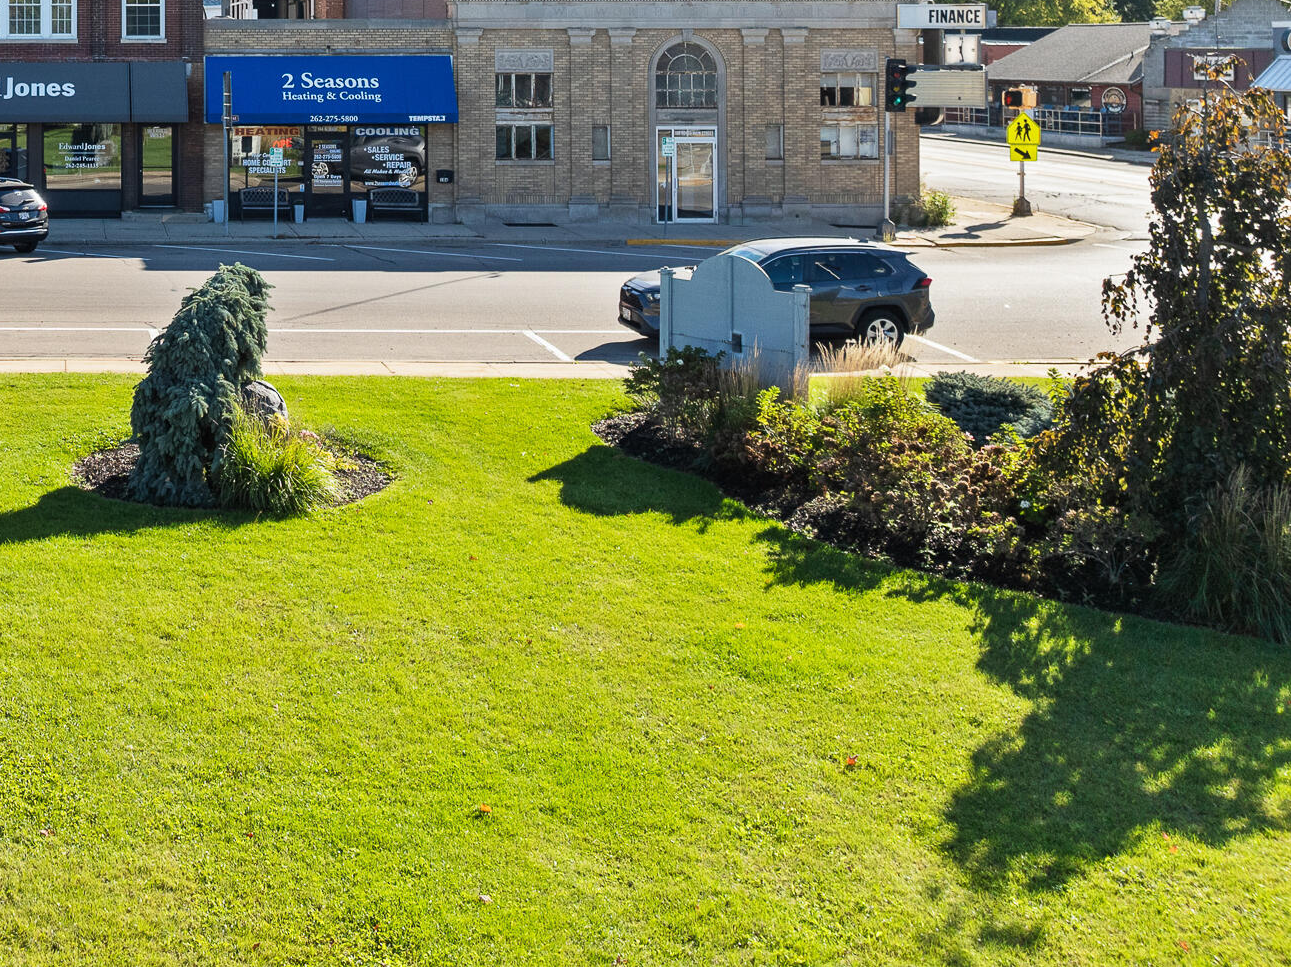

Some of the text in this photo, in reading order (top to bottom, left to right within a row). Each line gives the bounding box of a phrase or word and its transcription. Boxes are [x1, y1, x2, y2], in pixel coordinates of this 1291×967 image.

[929, 9, 981, 24] FINANCE
[281, 72, 380, 89] 2 Seasons
[282, 91, 382, 103] Heating & Cooling
[309, 115, 359, 123] 262-275-5800
[234, 127, 300, 136] HEATING
[355, 128, 420, 136] COOLING
[367, 146, 390, 154] SALES
[386, 161, 412, 169] REPAIR
